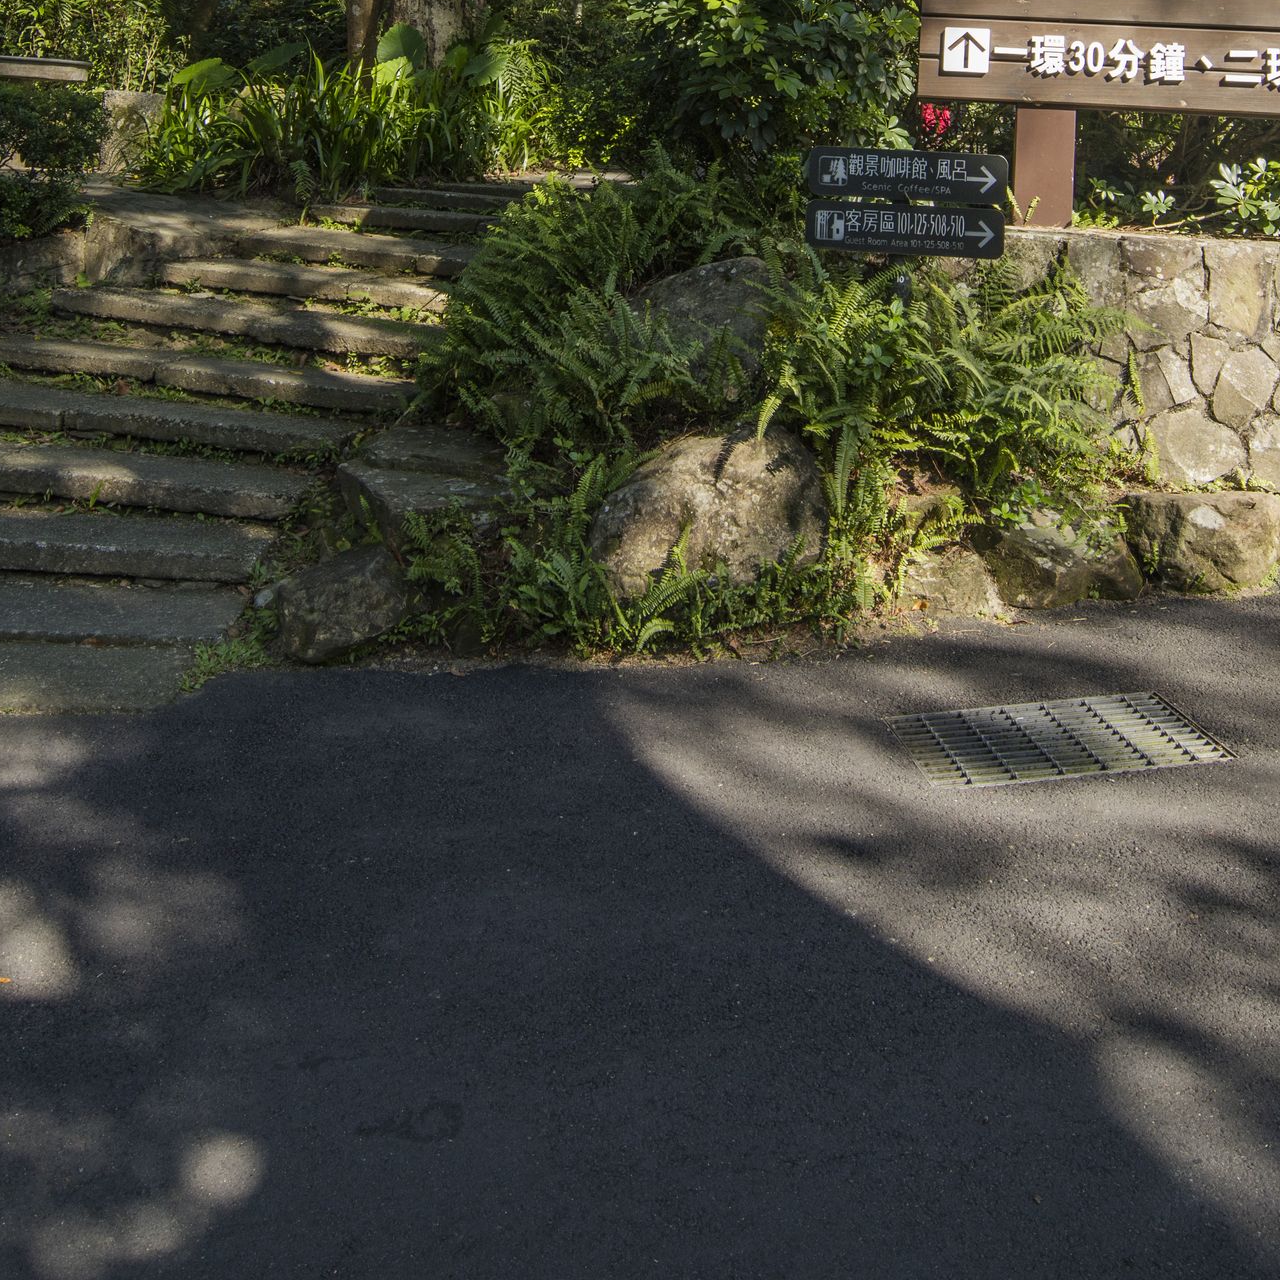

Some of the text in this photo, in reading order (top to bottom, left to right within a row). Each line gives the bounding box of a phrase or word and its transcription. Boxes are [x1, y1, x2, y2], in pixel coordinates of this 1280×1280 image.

[861, 181, 952, 195] Scenic Coffee/SPA
[845, 235, 865, 245] Guest
[867, 236, 888, 246] Room
[891, 239, 909, 248] Area
